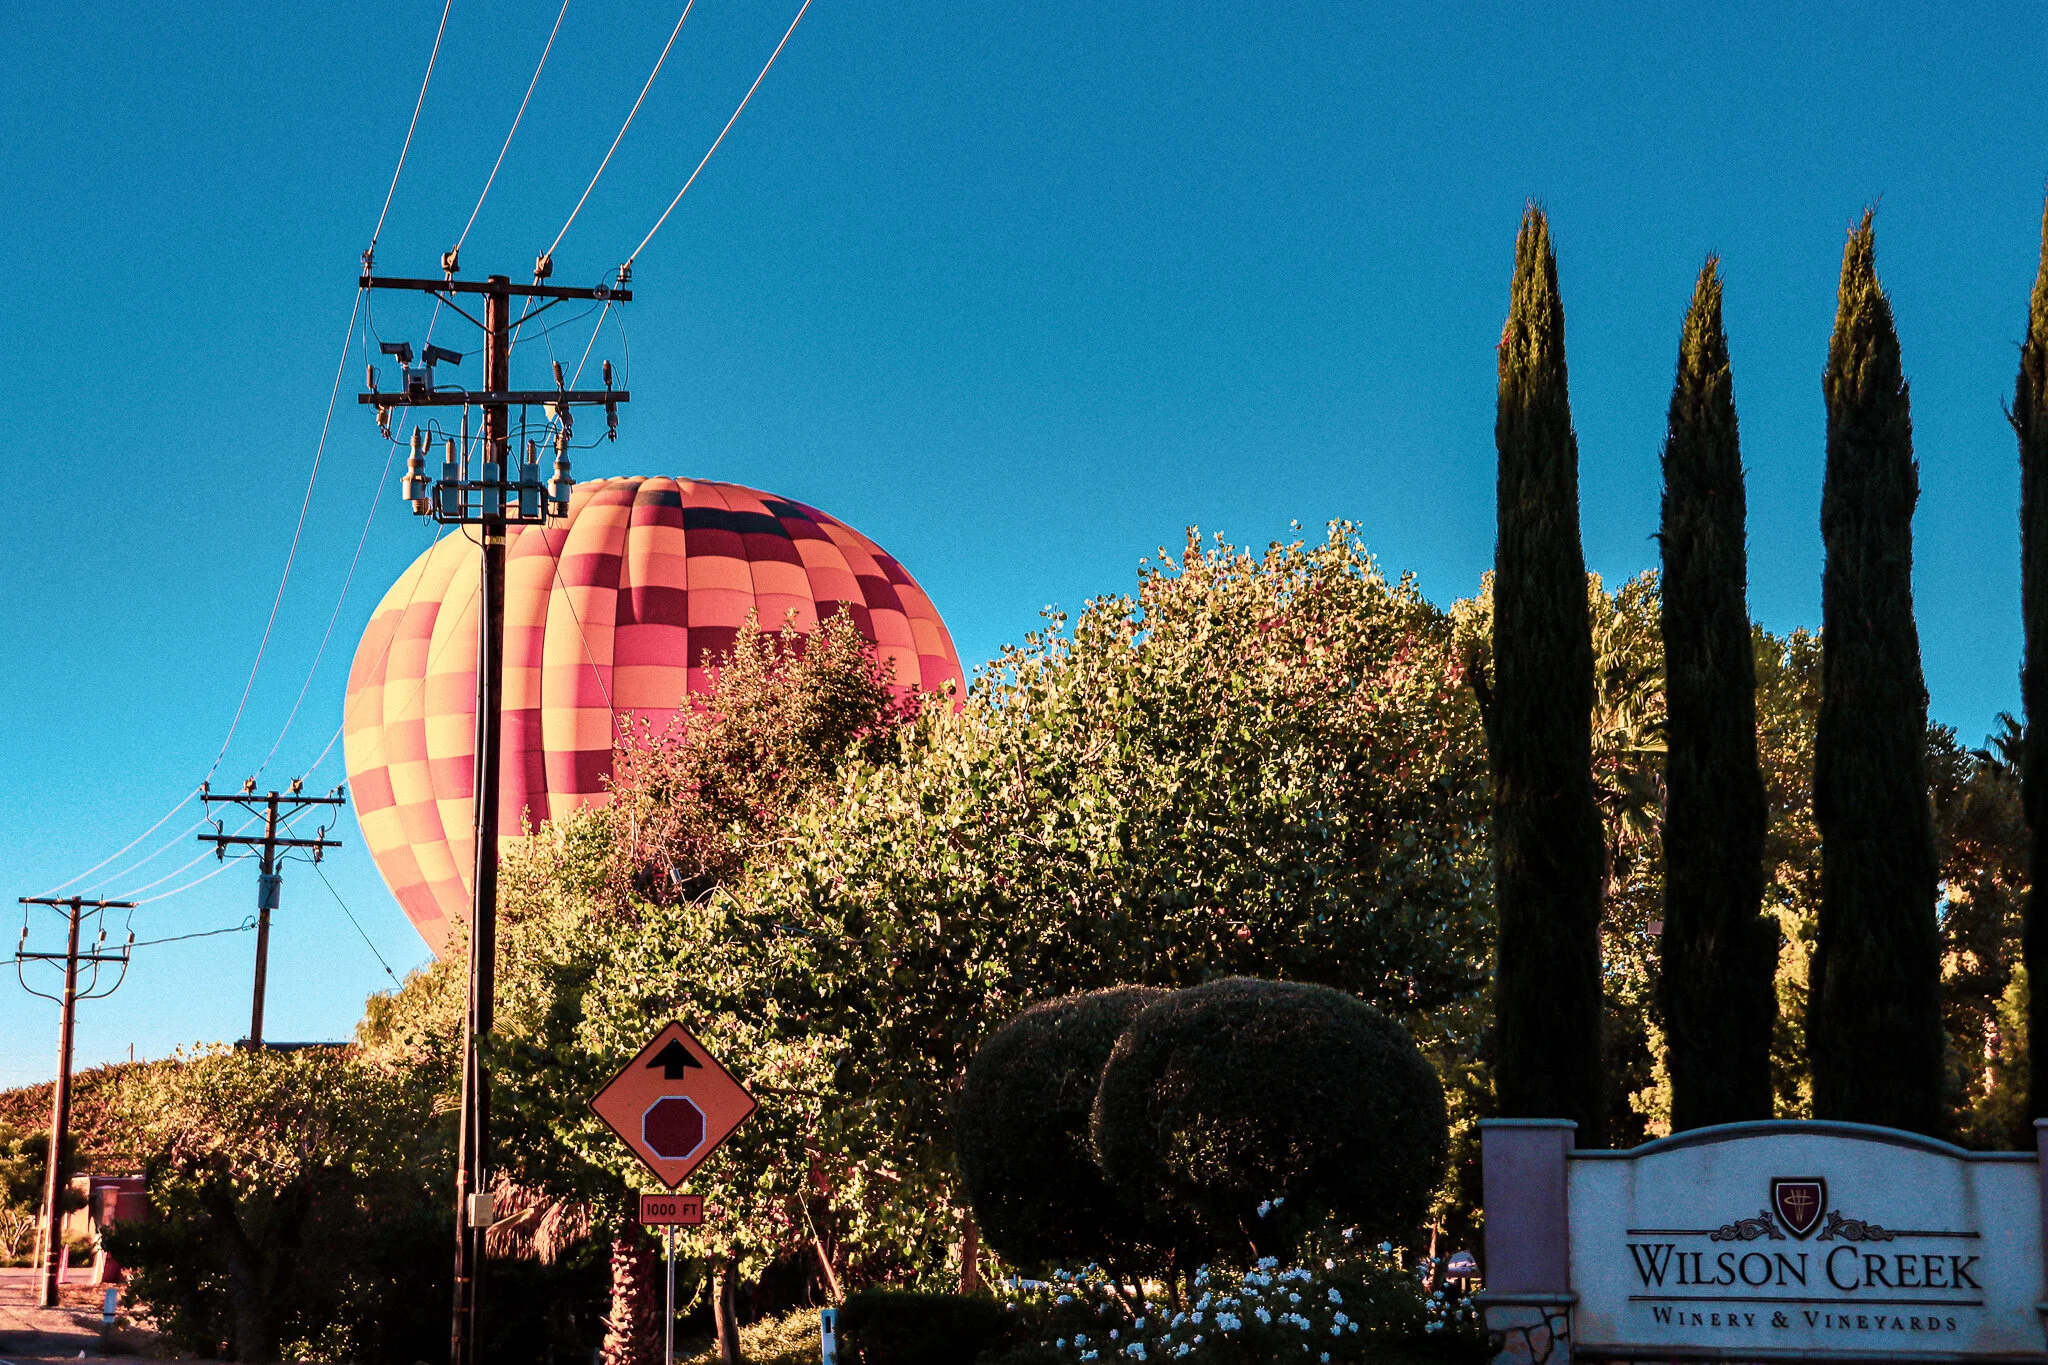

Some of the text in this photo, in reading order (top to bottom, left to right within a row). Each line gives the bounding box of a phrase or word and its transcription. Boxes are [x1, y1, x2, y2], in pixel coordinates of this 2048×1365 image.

[647, 1203, 697, 1216] 1000 FT
[1626, 1243, 1983, 1290] WILSON CREEK
[1652, 1306, 1957, 1331] WINERY & VINEYARDS
